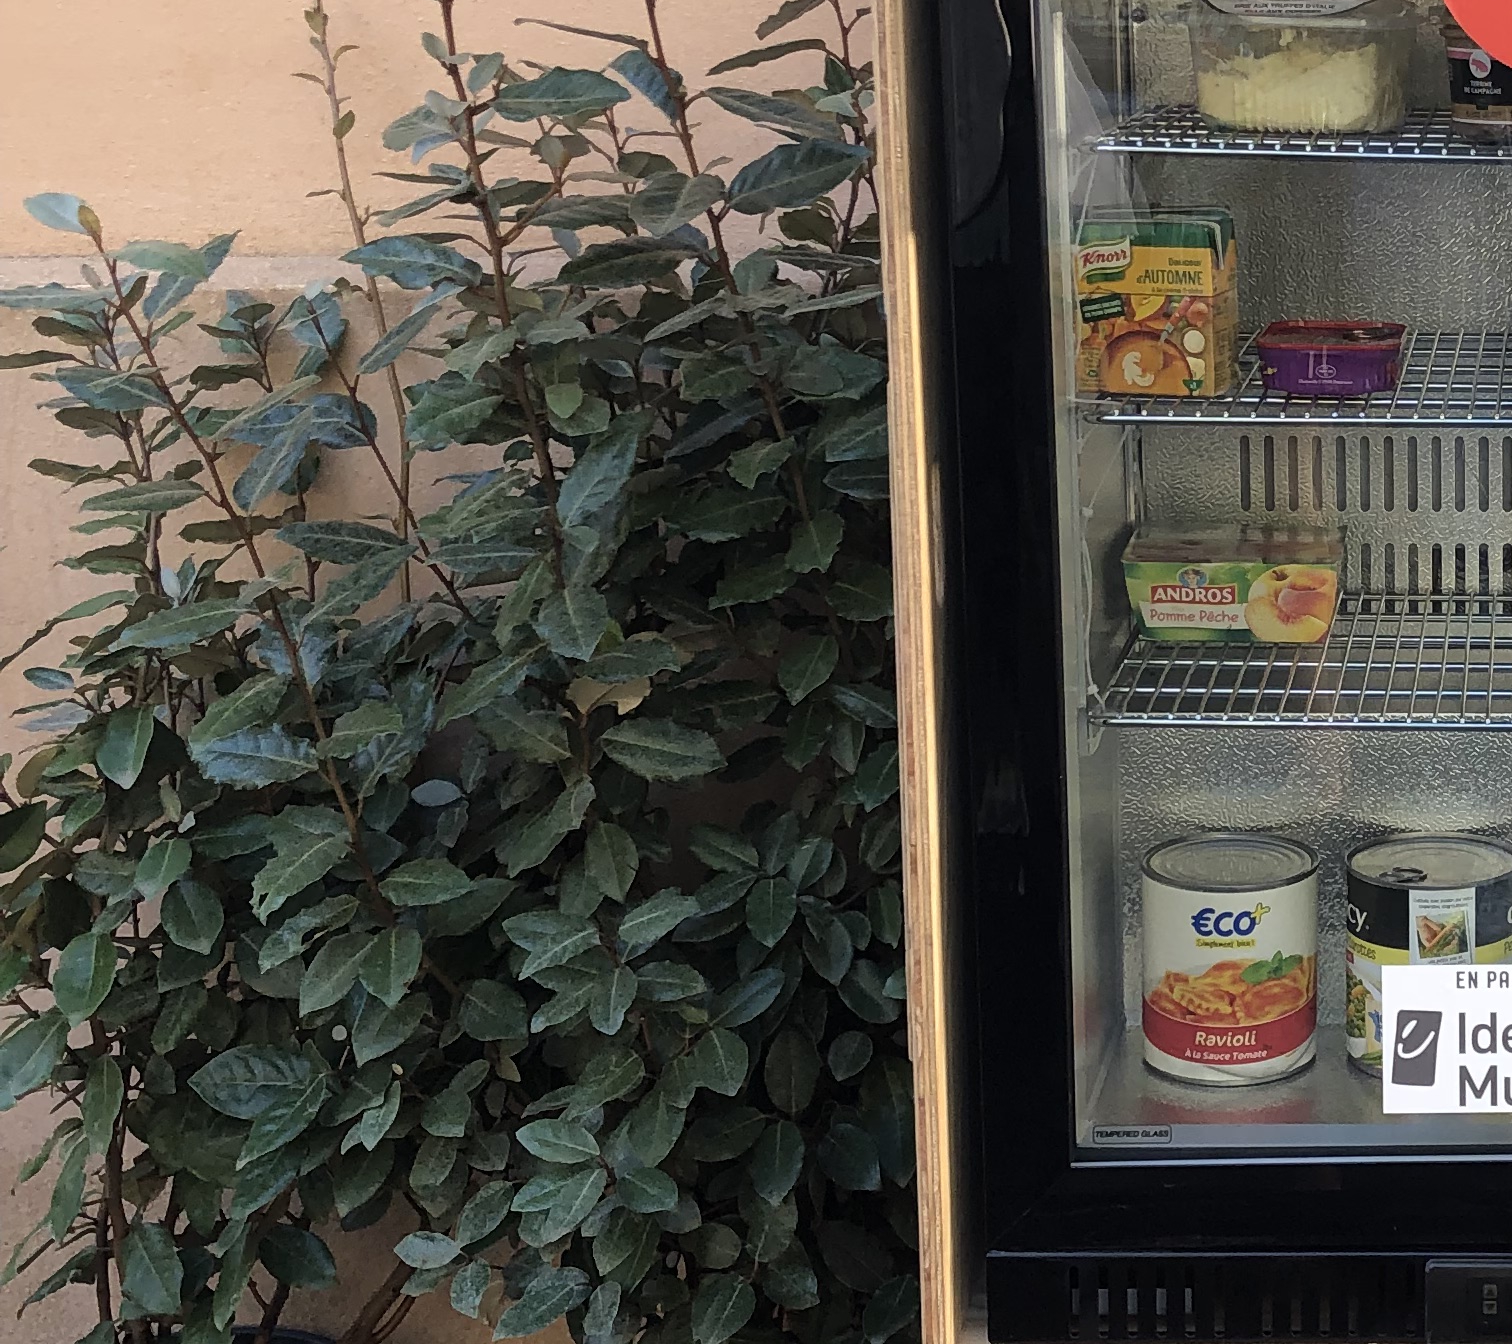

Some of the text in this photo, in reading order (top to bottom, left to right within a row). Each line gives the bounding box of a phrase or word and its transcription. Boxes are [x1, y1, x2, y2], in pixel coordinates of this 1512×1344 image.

[1080, 249, 1127, 268] Knorr
[1153, 587, 1233, 603] ANDROS
[1149, 609, 1239, 623] Pomme Pêche
[1456, 970, 1478, 989] EN
[1194, 1030, 1257, 1047] Ravioli
[1202, 1052, 1231, 1061] Sauce
[1232, 1049, 1268, 1060] Tomate
